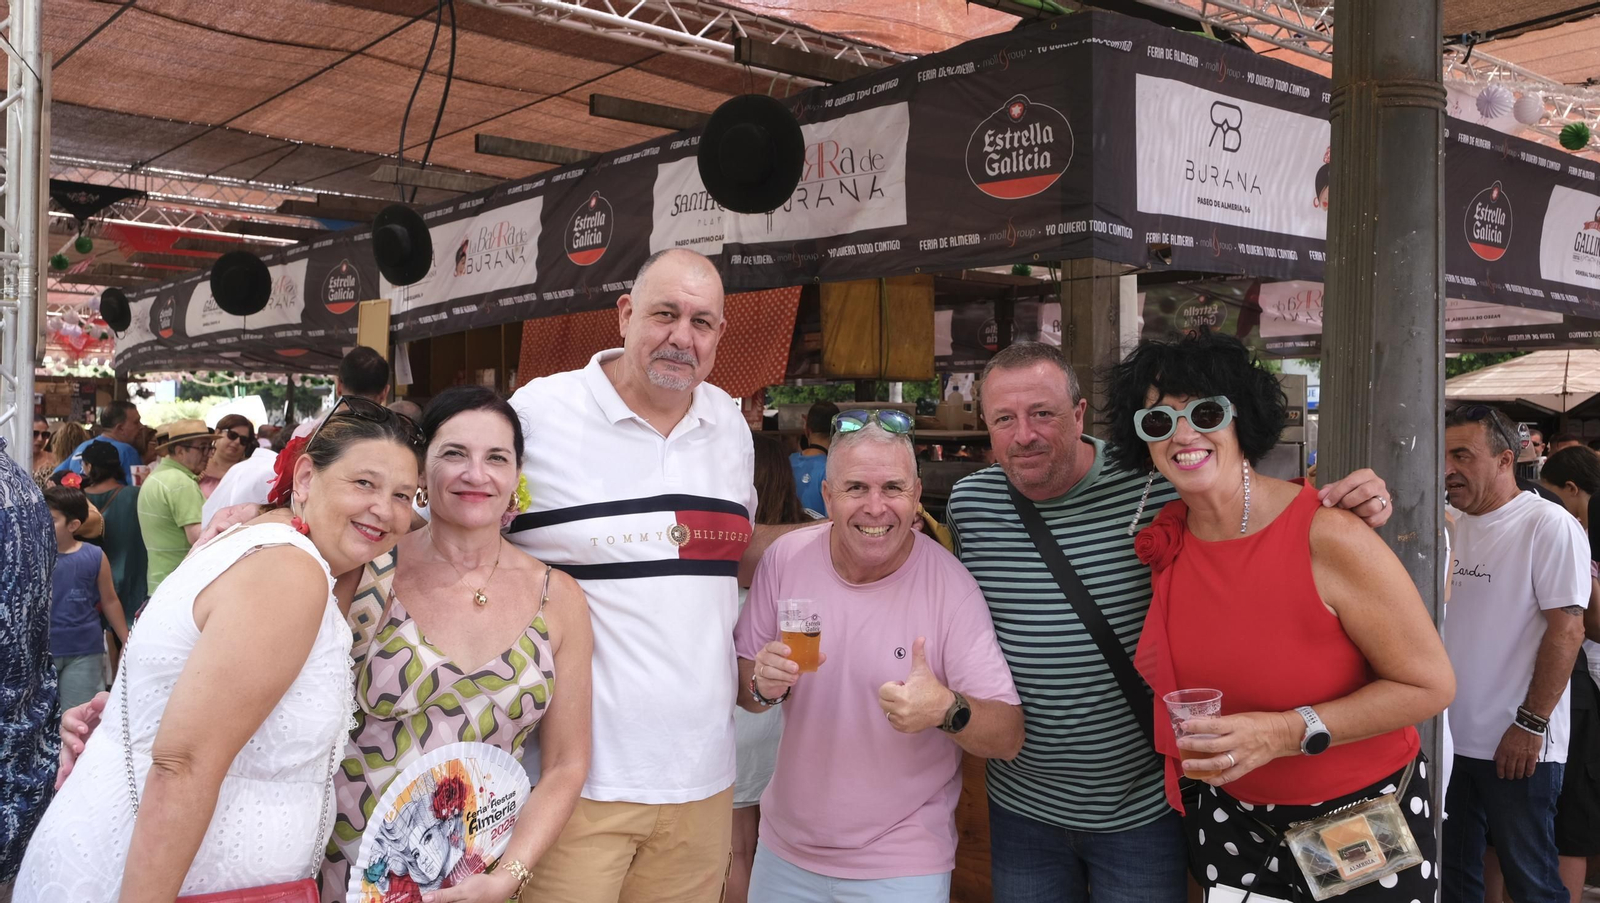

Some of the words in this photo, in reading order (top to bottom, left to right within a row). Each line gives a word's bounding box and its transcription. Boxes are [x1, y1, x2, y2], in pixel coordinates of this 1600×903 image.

[918, 68, 937, 83] FERIA
[1147, 45, 1164, 59] FERIA
[1165, 49, 1173, 61] DE
[1174, 49, 1199, 68] ALMERIA
[1247, 72, 1255, 84] YO
[1256, 74, 1274, 88] QUIERO
[1275, 79, 1288, 92] TODO
[1289, 83, 1310, 98] CONTIGO
[824, 99, 833, 108] YO
[834, 93, 855, 107] QUIERO
[872, 78, 899, 95] CONTIGO
[983, 122, 1055, 153] Estrella
[860, 149, 885, 172] de
[985, 149, 1052, 176] Galicia
[1185, 159, 1262, 195] BURANA
[783, 175, 884, 212] URANA
[1197, 197, 1213, 207] PASEO
[1214, 199, 1221, 208] DE
[573, 211, 606, 232] Estrella
[1473, 201, 1506, 226] Estrella
[573, 228, 602, 249] Galicia
[919, 239, 938, 251] FERIA
[939, 237, 949, 249] DE
[950, 233, 980, 247] ALMERIA
[1045, 225, 1056, 236] YO
[1058, 220, 1087, 234] QUIERO
[1089, 219, 1107, 233] TODO
[1108, 224, 1133, 240] CONTIGO
[1473, 221, 1502, 244] Galicia
[858, 243, 874, 253] TODO
[875, 240, 900, 252] CONTIGO
[1146, 232, 1161, 244] FERIA
[1162, 233, 1170, 244] DE
[1170, 234, 1194, 247] ALMERIA
[1238, 243, 1245, 254] YO
[1246, 244, 1264, 256] QUIERO
[1264, 247, 1277, 258] TODO
[1277, 248, 1298, 260] CONTIGO
[1309, 250, 1322, 261] FERIA
[467, 246, 526, 275] BURANA
[328, 287, 354, 301] Galicia
[329, 275, 355, 288] Estrella
[590, 532, 663, 547] TOMMY
[693, 529, 748, 543] HILFIGER
[1453, 559, 1491, 583] Cardin
[469, 800, 516, 835] Almería
[491, 815, 516, 841] 2025
